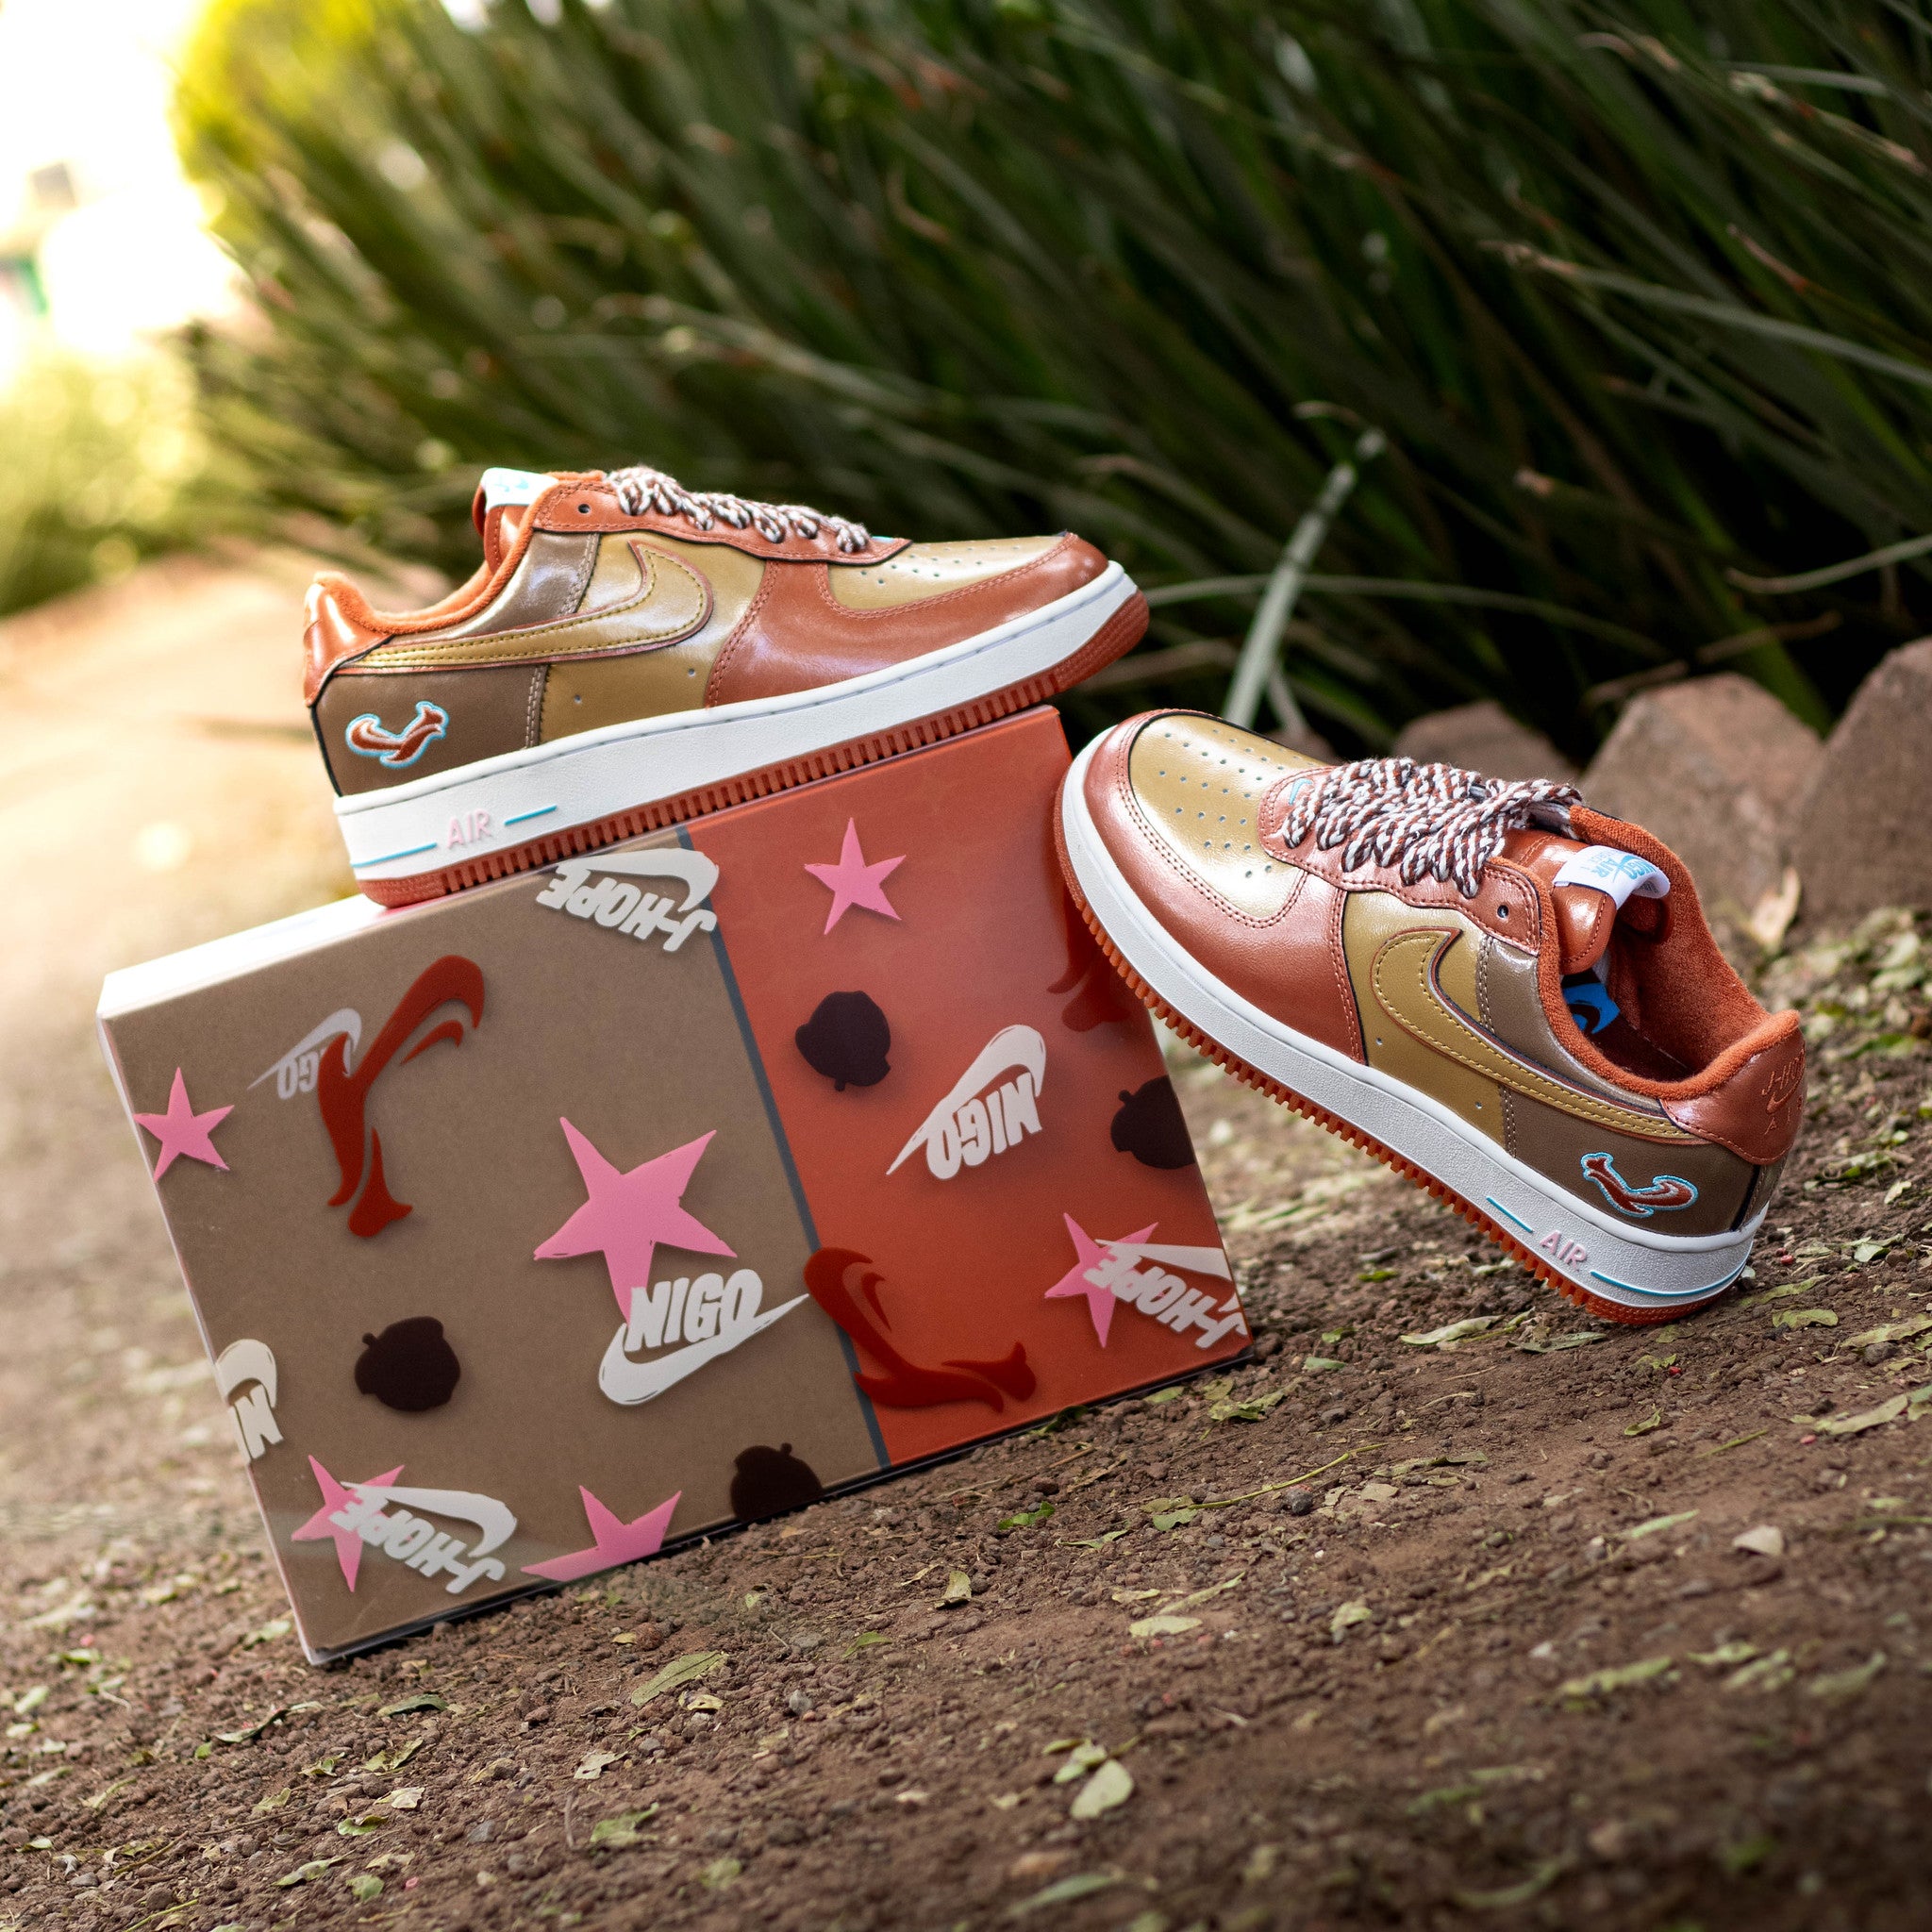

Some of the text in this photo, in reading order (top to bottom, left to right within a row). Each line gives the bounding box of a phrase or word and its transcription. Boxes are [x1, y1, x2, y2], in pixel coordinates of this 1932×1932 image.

[447, 809, 491, 849] AIR
[536, 862, 718, 952] J-HOPE
[926, 1073, 1041, 1179] NIGO
[1540, 1230, 1587, 1273] AIR
[625, 1269, 763, 1353] NIGO
[1083, 1245, 1248, 1349] J-HOPE
[328, 1488, 506, 1594] J-HOPE
